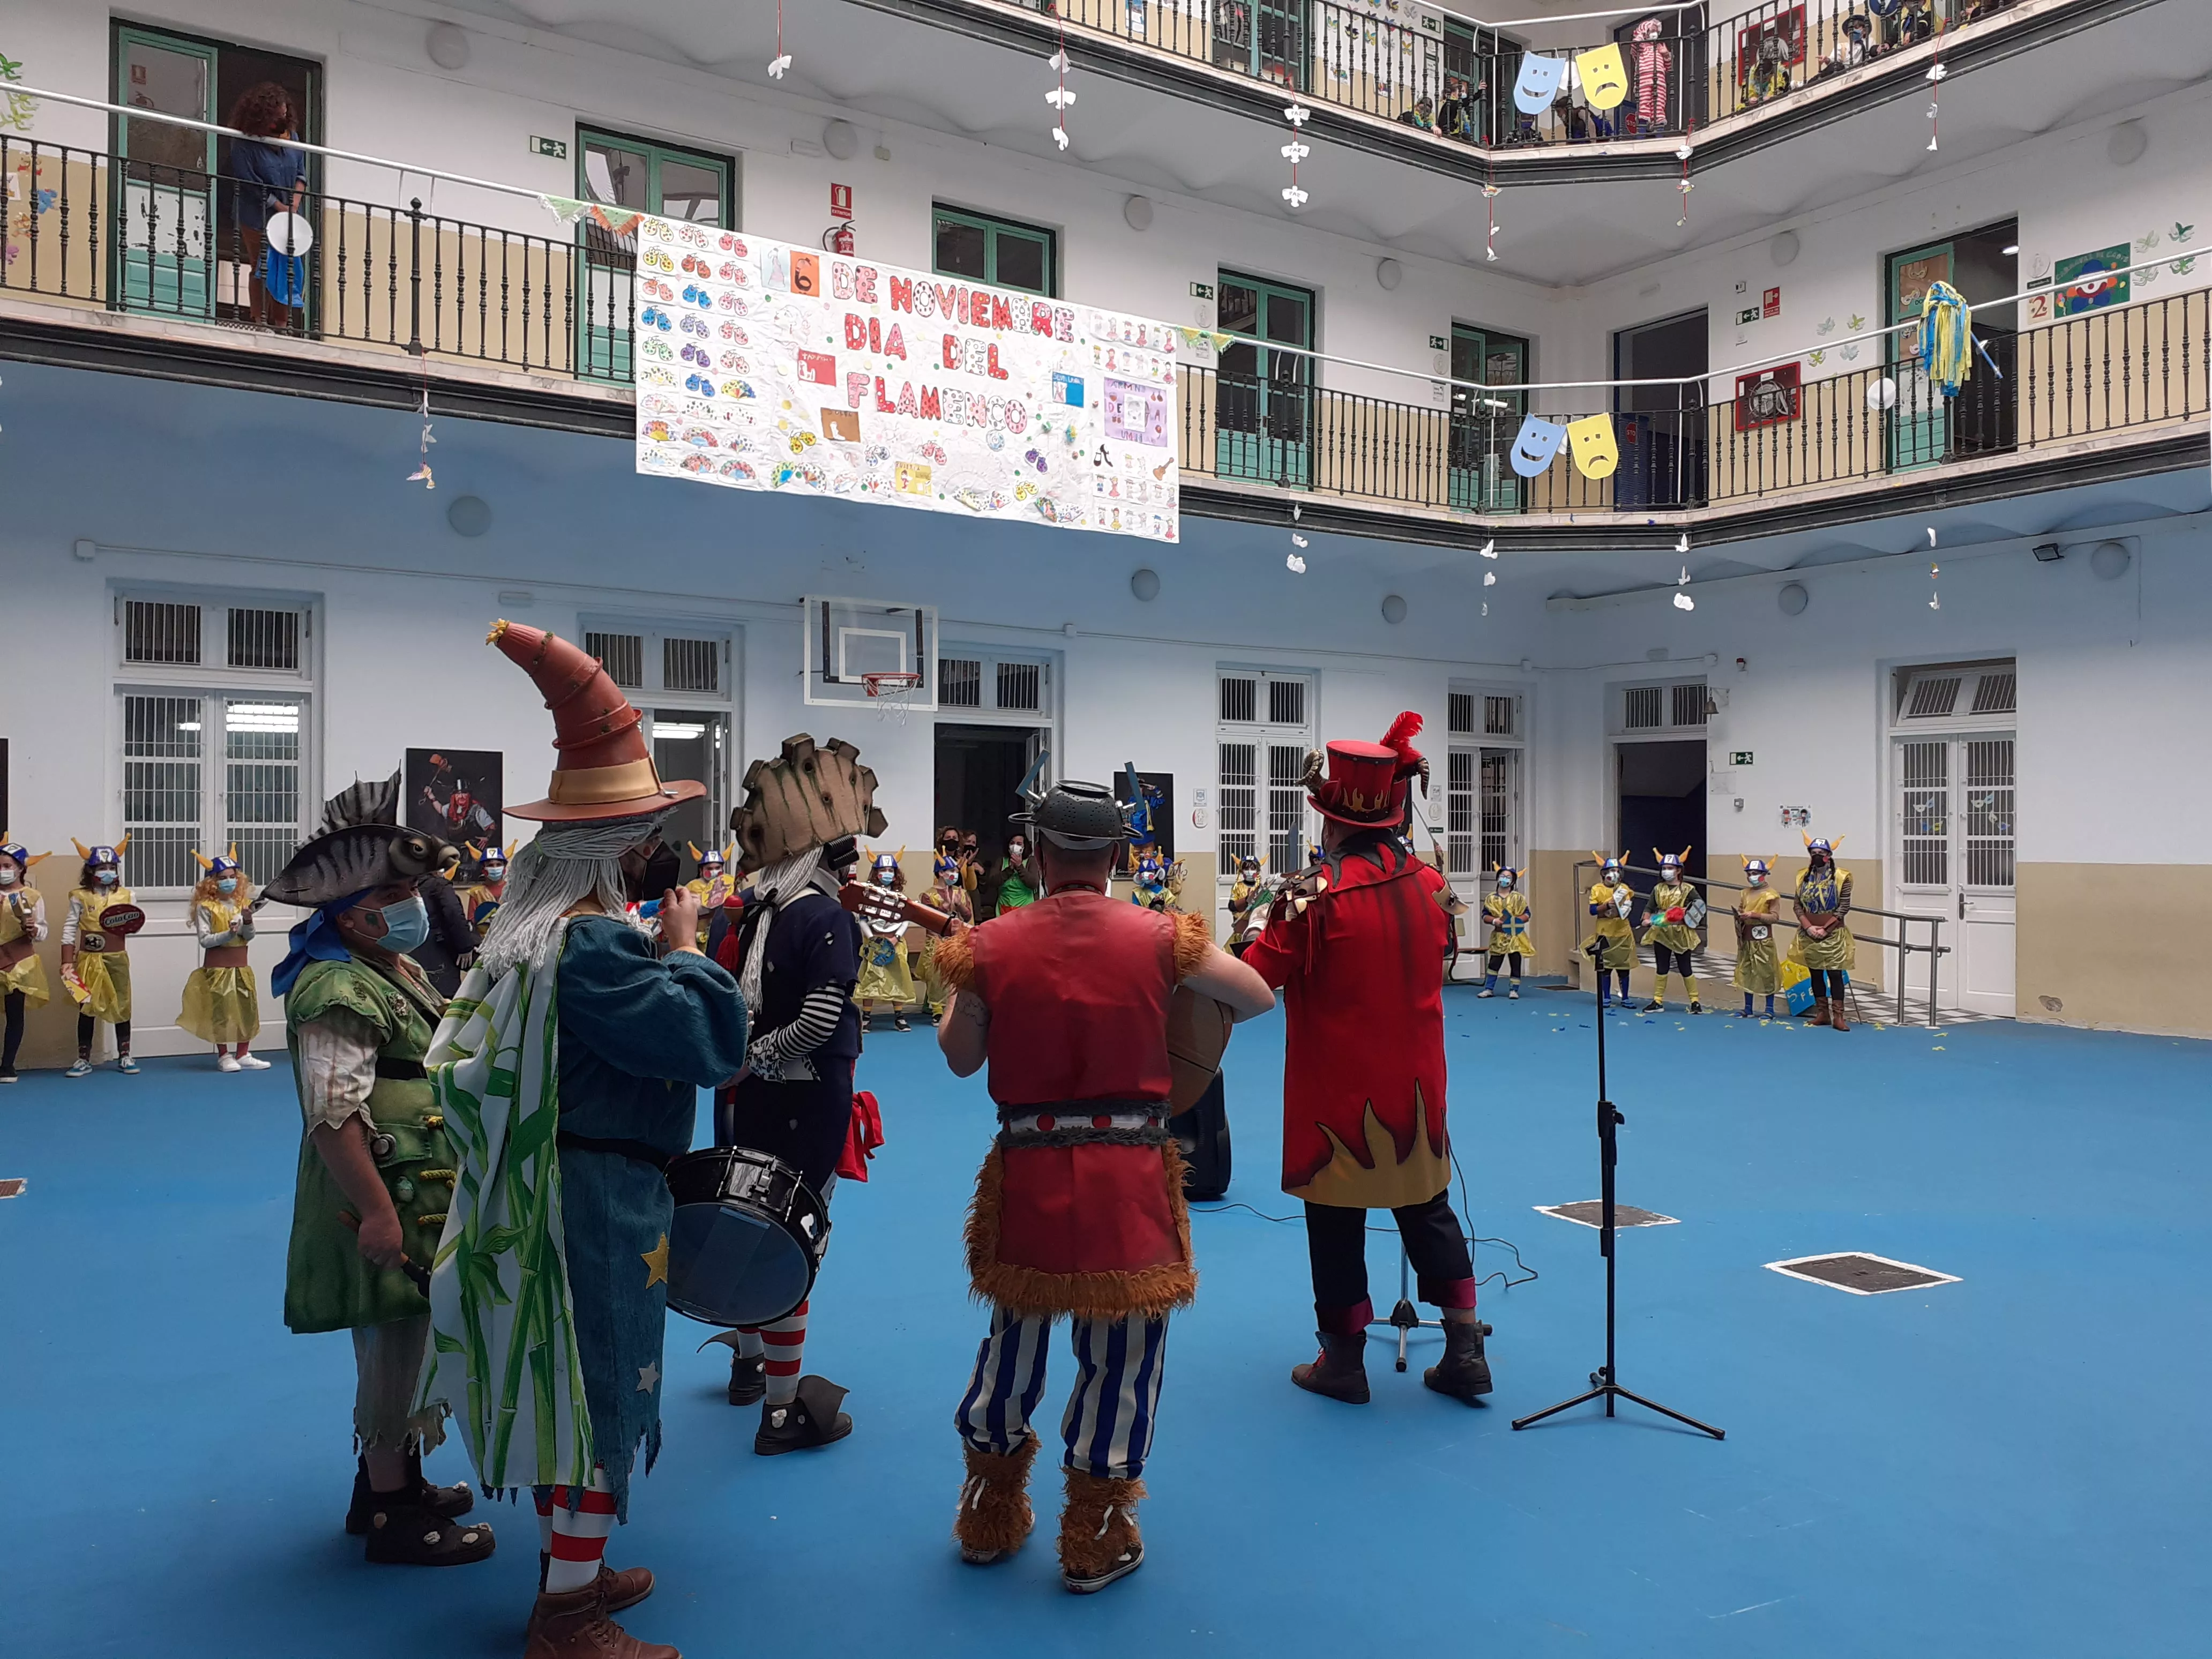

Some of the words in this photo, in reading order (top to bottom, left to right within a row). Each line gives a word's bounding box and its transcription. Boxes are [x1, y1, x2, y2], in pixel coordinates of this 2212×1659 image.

[832, 261, 878, 304] DE
[890, 275, 1075, 343] NOVIEMBRE
[2032, 295, 2048, 318] 2
[845, 312, 907, 361] DIA
[942, 333, 1010, 380] DEL
[846, 371, 1028, 435] FLAMENCO
